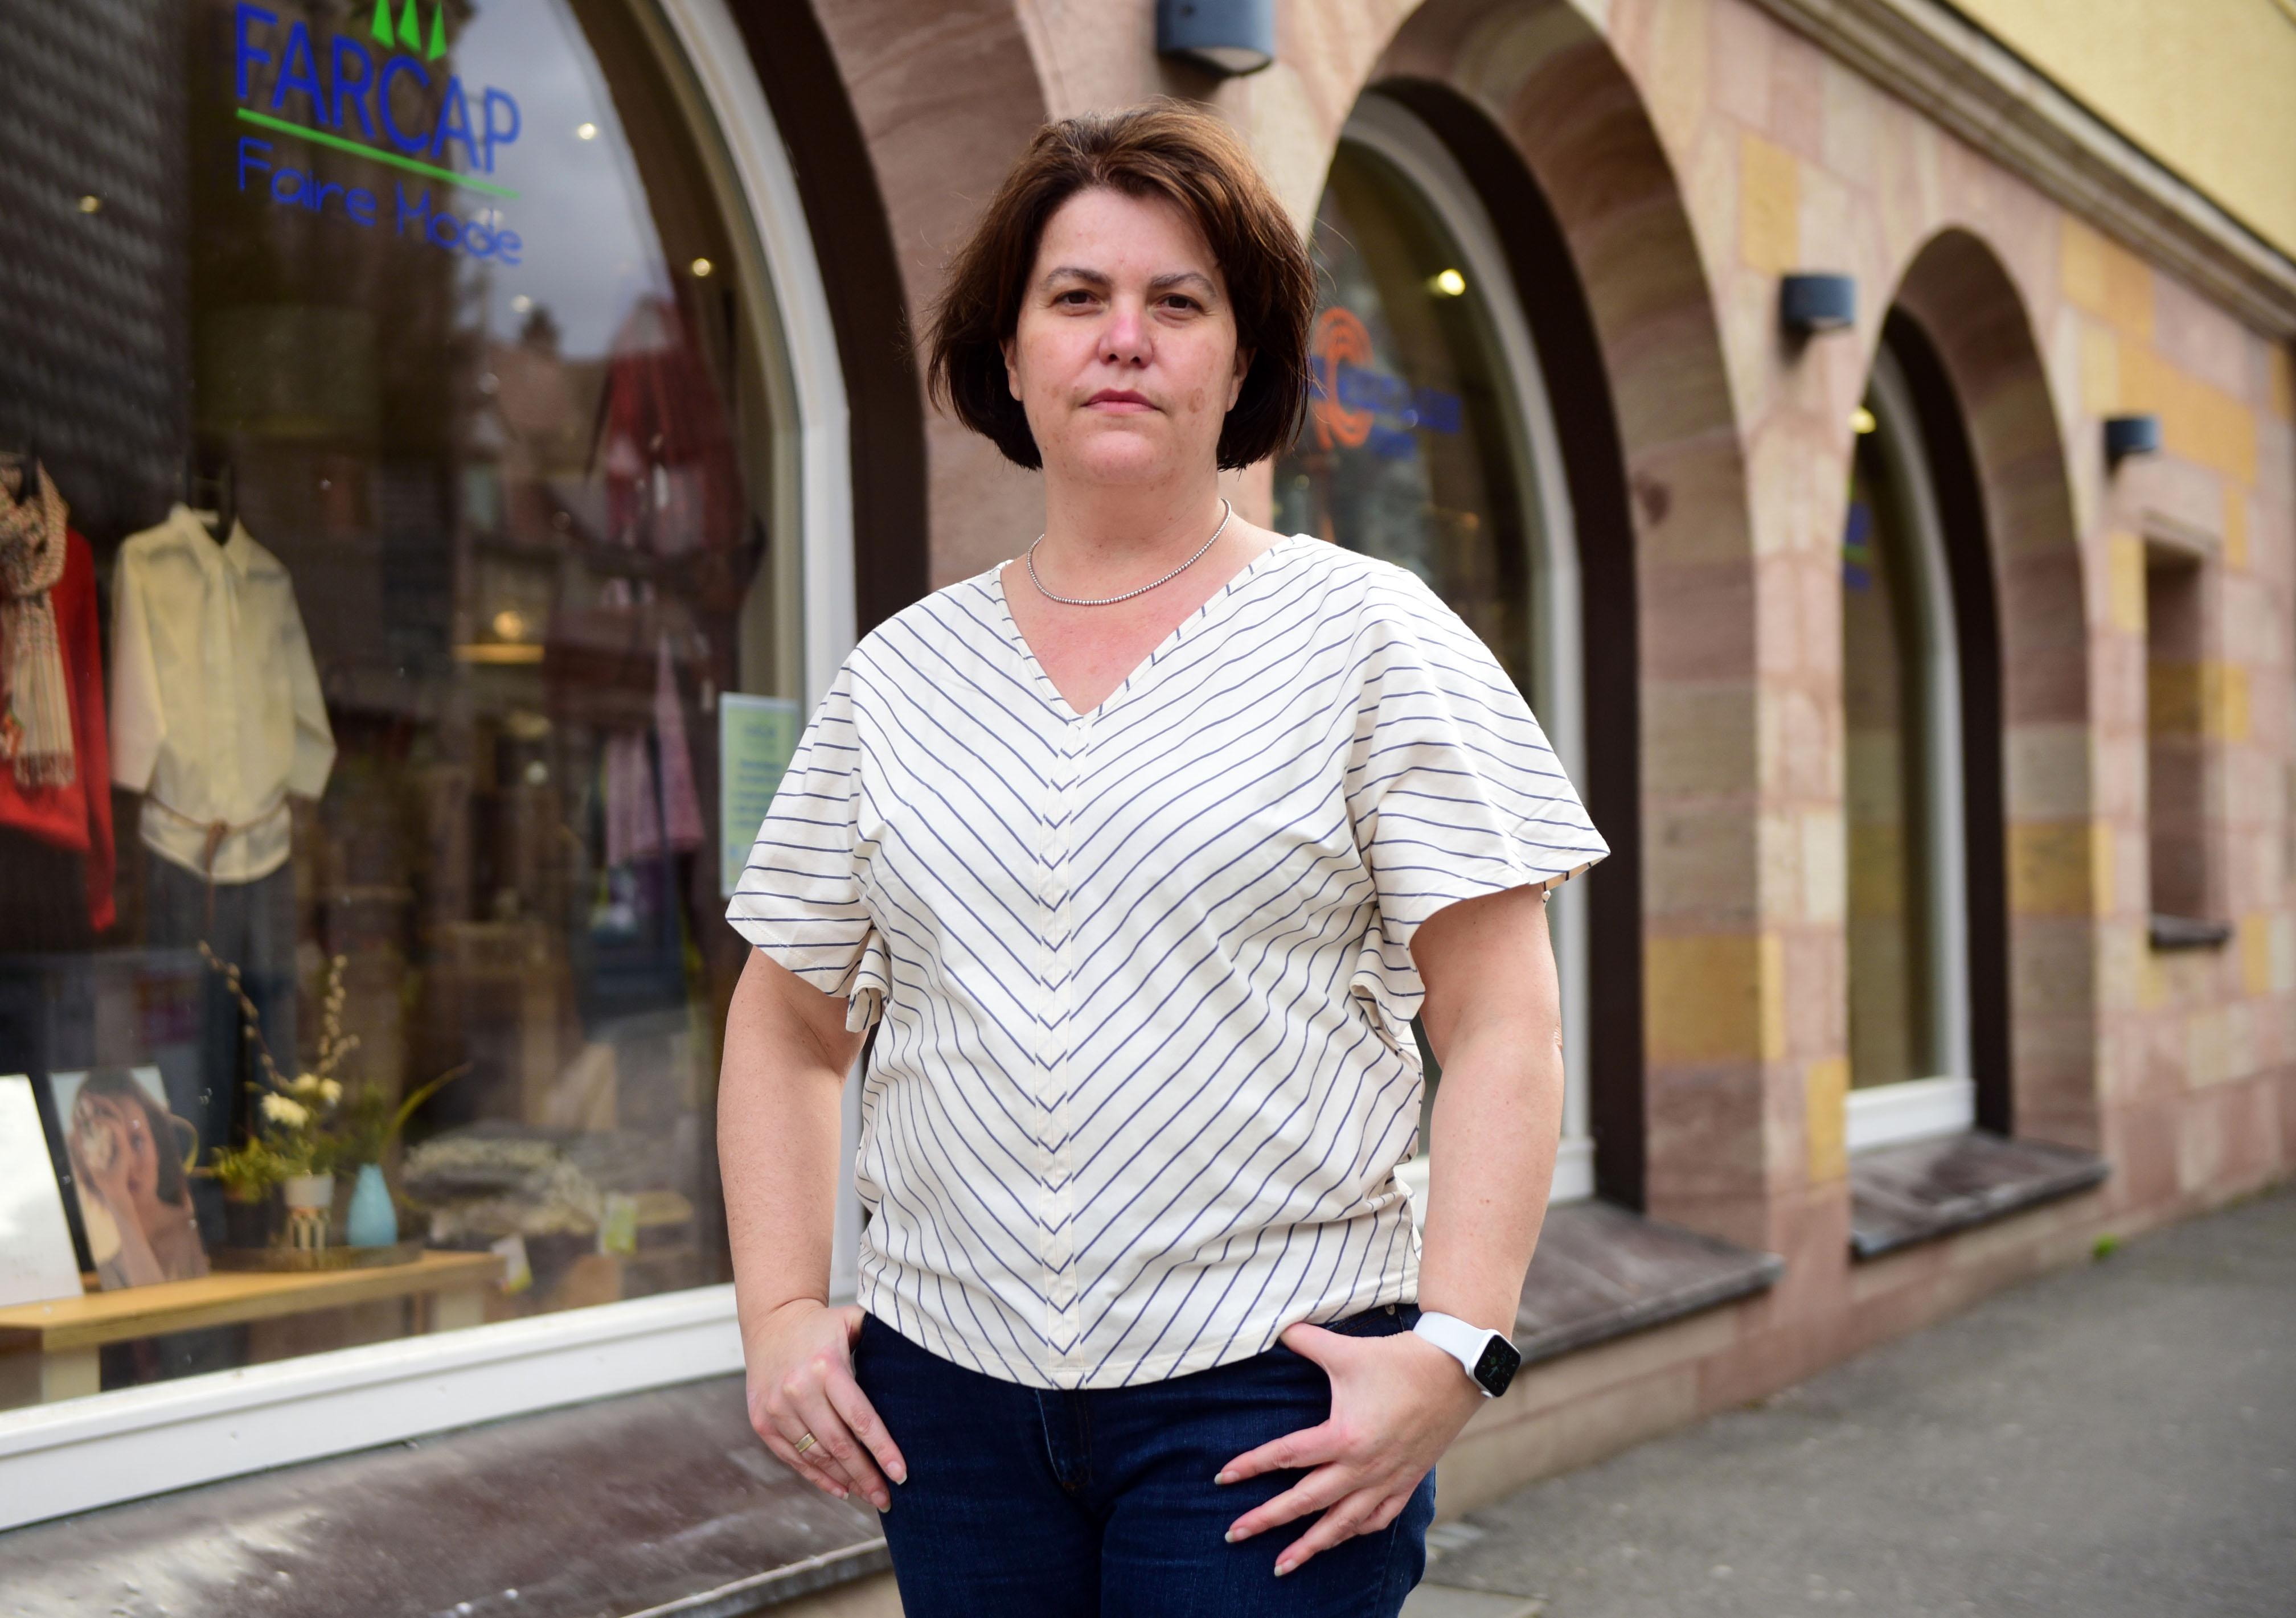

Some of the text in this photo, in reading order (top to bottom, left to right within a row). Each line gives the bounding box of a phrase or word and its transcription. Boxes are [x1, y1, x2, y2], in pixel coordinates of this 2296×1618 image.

[237, 2, 521, 174] FARCAP
[238, 137, 522, 265] Faire Mode
